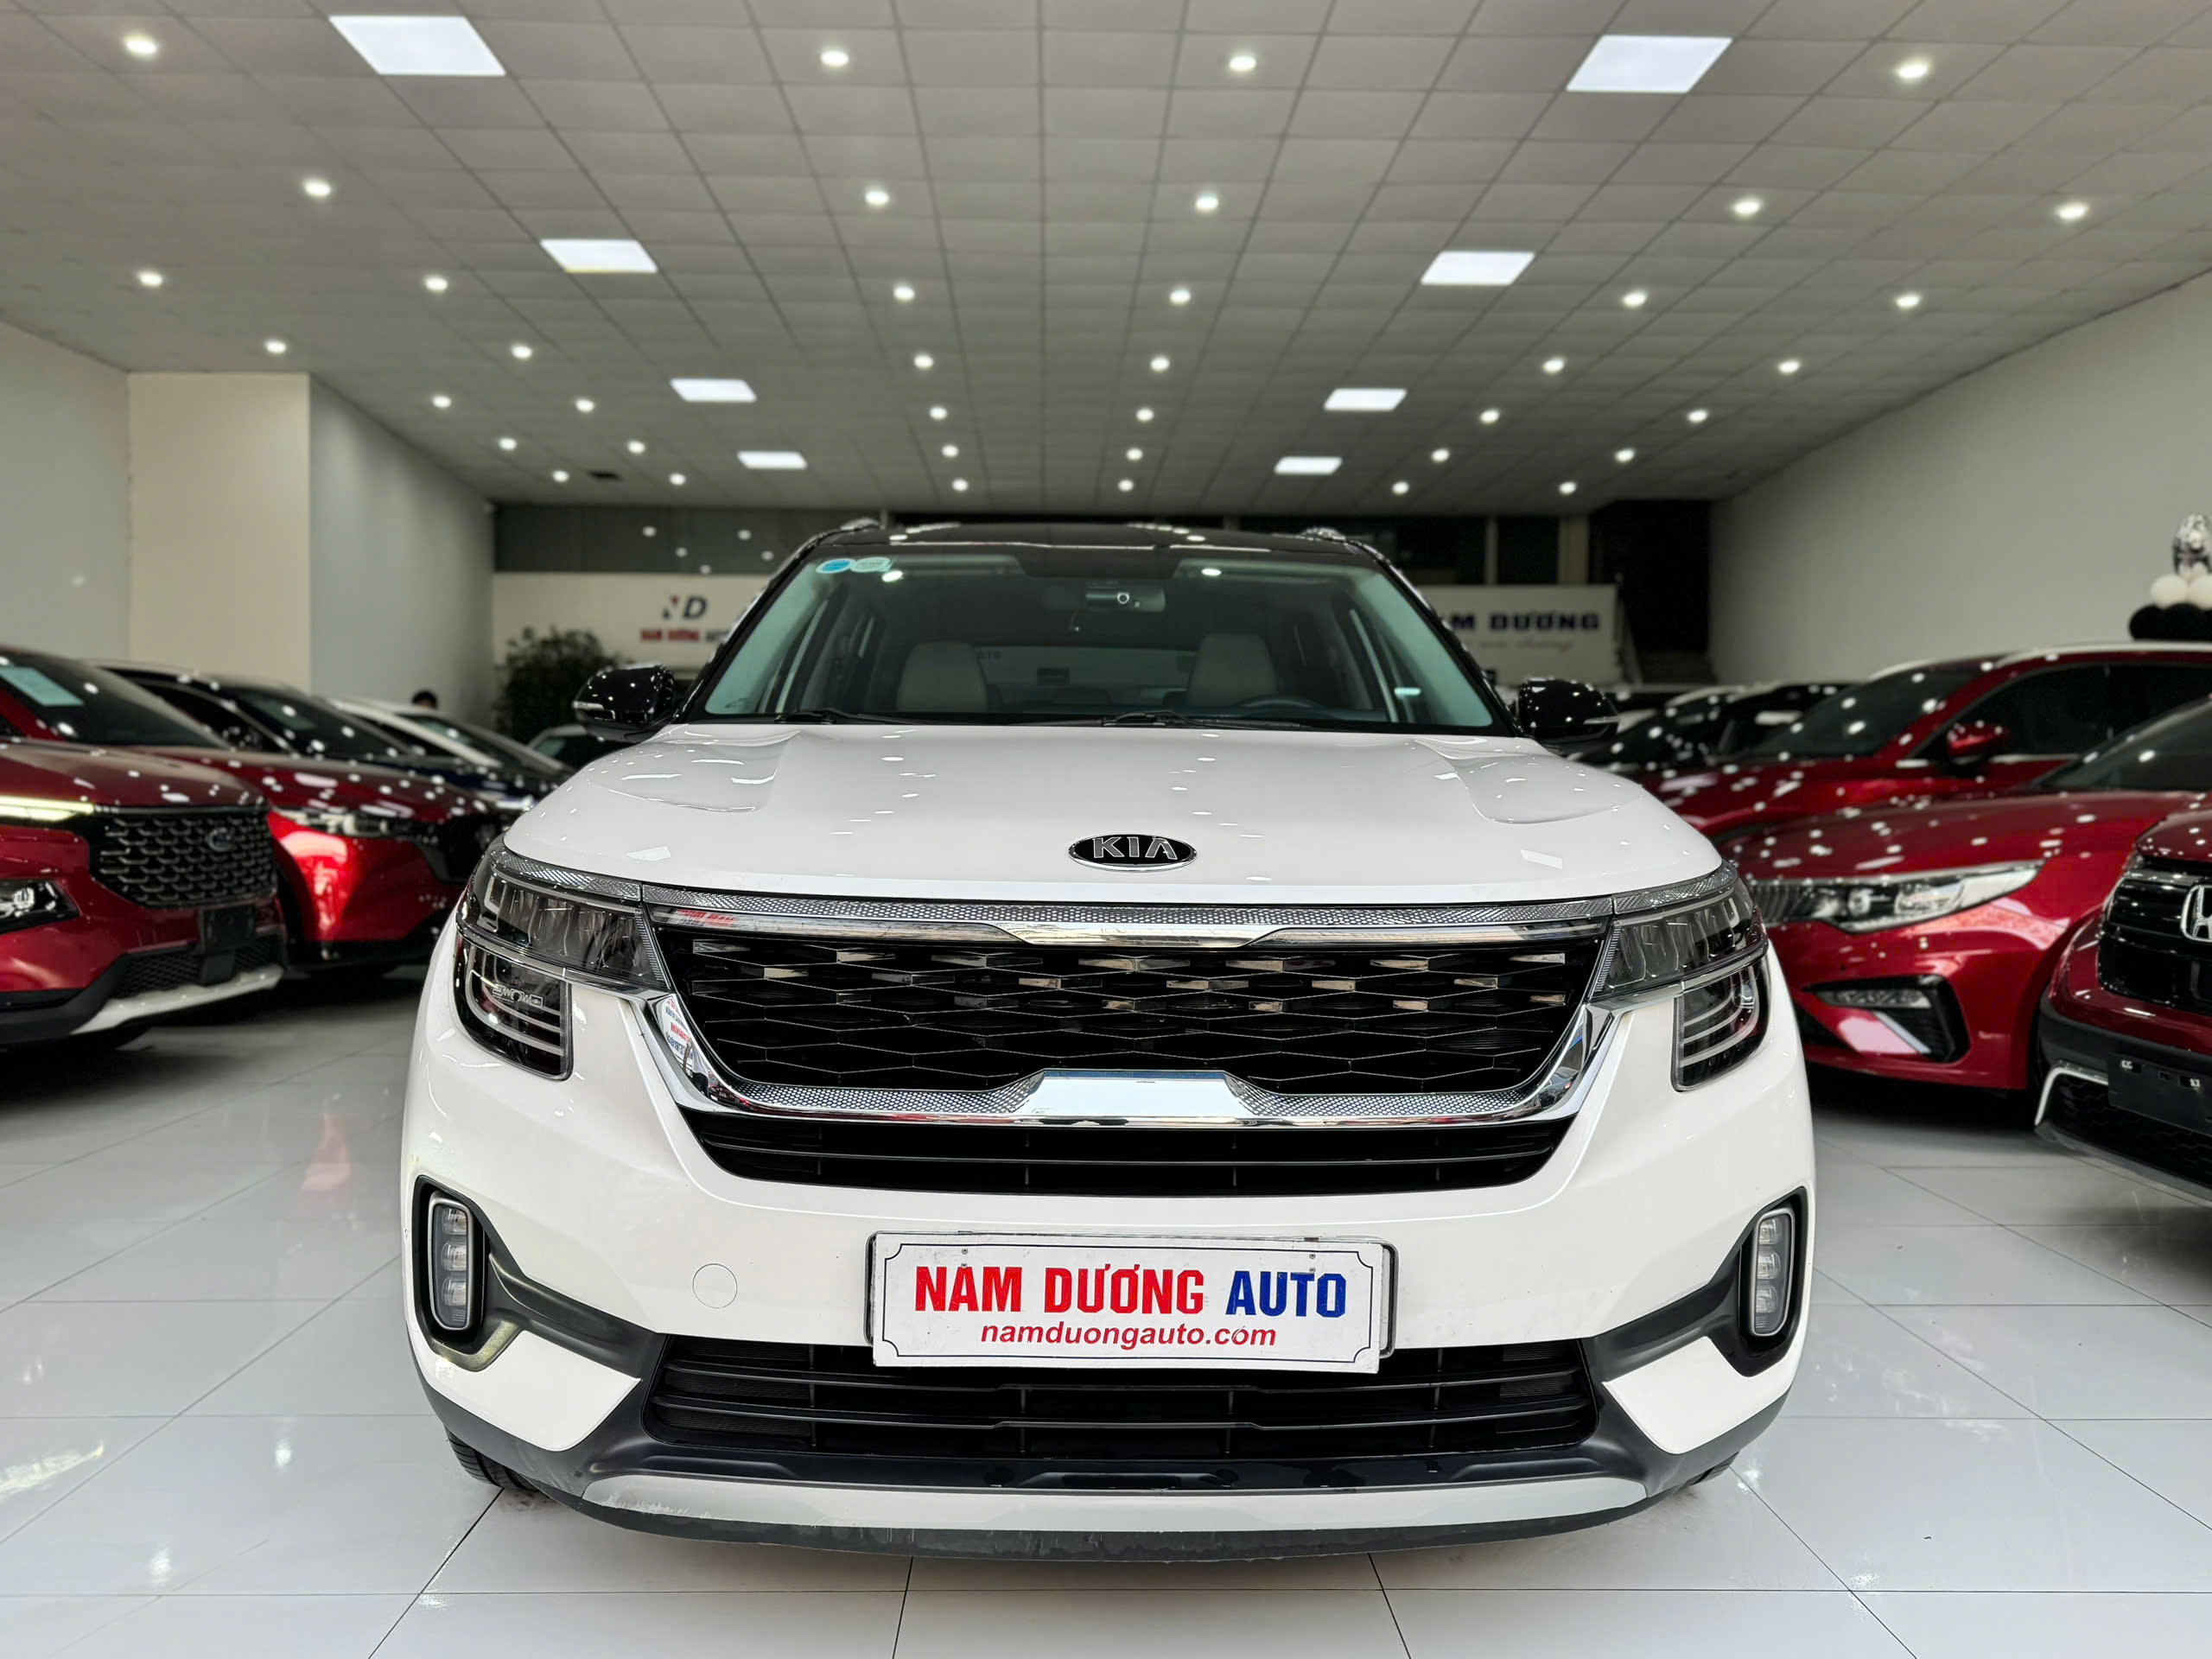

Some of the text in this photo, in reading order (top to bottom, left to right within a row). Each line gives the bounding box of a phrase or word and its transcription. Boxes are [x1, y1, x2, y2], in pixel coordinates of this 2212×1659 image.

[1092, 836, 1178, 860] KIA
[915, 1263, 1346, 1318] NAM DƯƠNG AUTO
[981, 1321, 1276, 1351] namduongauto.com
